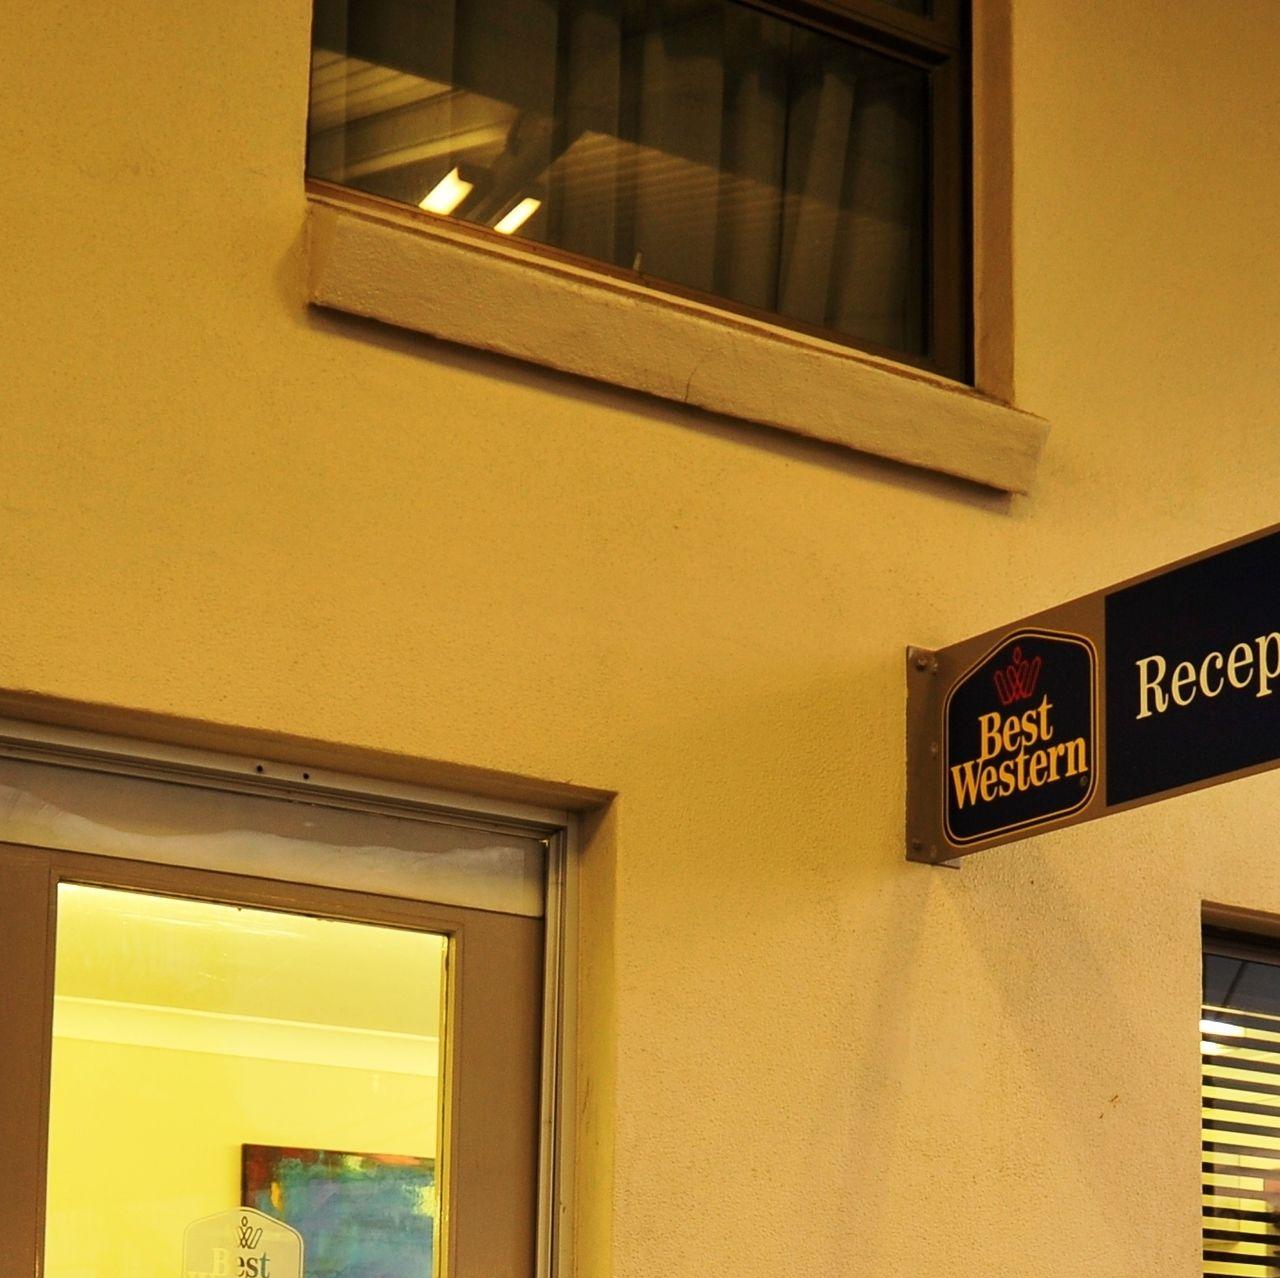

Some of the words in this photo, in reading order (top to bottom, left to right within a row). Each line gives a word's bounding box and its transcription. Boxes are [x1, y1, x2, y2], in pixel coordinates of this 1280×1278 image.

[978, 694, 1053, 762] Best
[951, 735, 1088, 809] Western
[212, 1248, 270, 1278] Best
